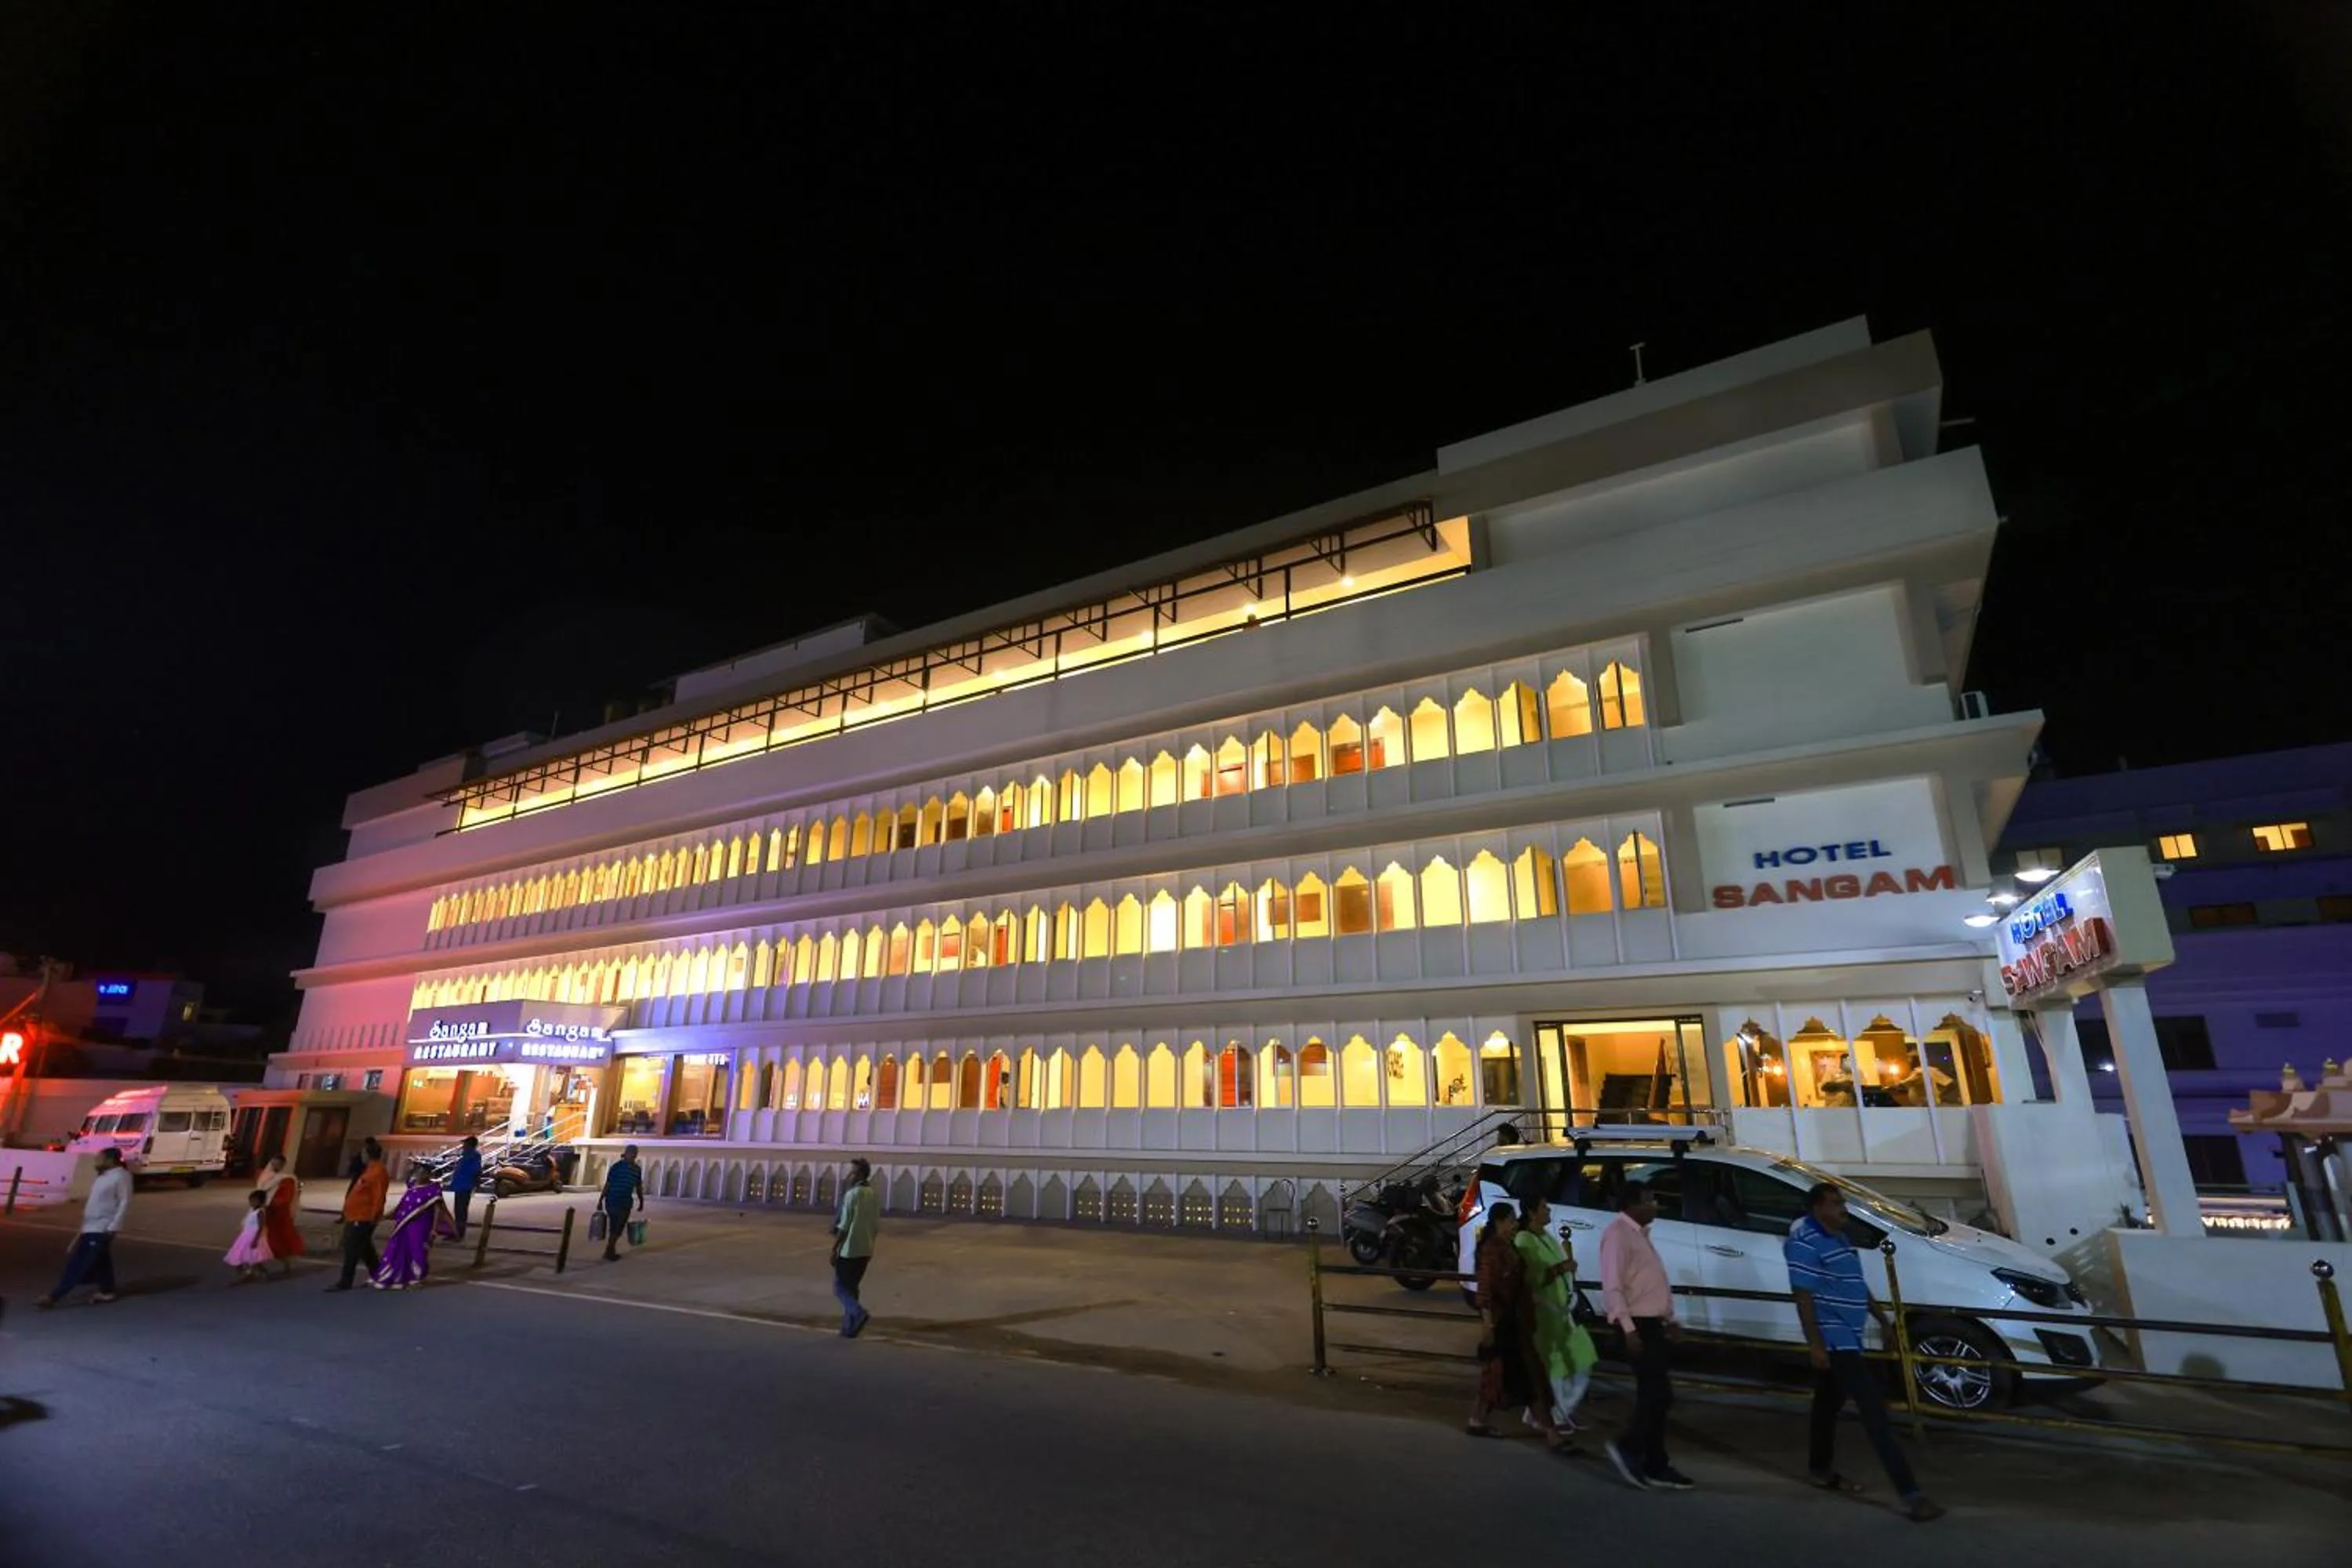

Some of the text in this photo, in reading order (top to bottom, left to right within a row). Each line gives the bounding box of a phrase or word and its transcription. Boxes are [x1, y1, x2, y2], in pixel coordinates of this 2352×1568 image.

[1753, 840, 1892, 869] HOTEL
[1712, 865, 1956, 909] SANGAM
[2010, 892, 2074, 944] HOTEL
[2001, 916, 2111, 996] SANGAM
[429, 1020, 489, 1043] Sangam
[526, 1018, 604, 1042] Sangam
